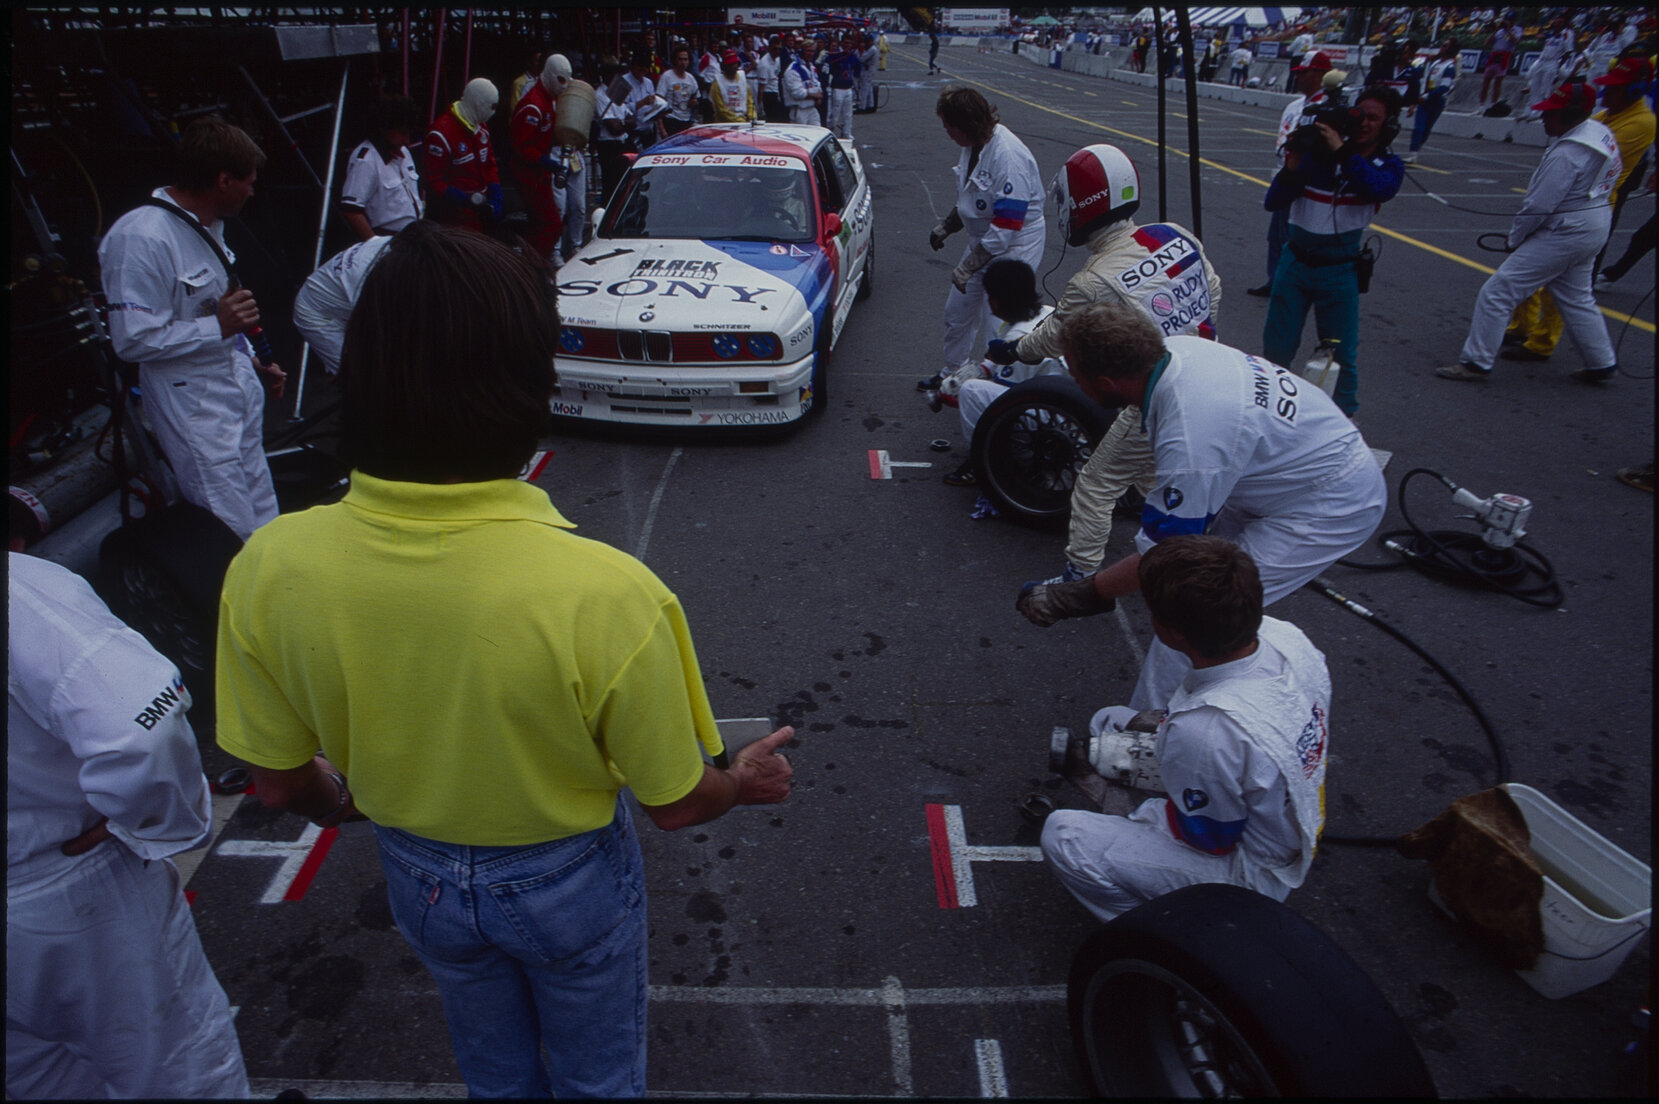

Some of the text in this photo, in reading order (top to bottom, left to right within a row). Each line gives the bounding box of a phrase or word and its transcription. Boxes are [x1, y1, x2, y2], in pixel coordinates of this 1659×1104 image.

[651, 155, 788, 167] Sony Car Audio
[1078, 188, 1109, 209] SONY
[579, 248, 635, 266] 1
[637, 259, 722, 271] BLACK
[1121, 239, 1188, 289] SONY
[631, 268, 717, 281] TRINITRON
[558, 278, 777, 303] SONY
[1171, 269, 1204, 303] RUDY
[577, 317, 597, 326] Team
[1160, 289, 1209, 337] PROJECT
[790, 324, 813, 347] SONY
[578, 381, 614, 392] SONY
[670, 387, 713, 396] SONY
[1253, 372, 1270, 409] BMW
[552, 402, 583, 416] Mobil
[716, 410, 790, 425] YOKOHAMA
[134, 686, 180, 730] BMW
